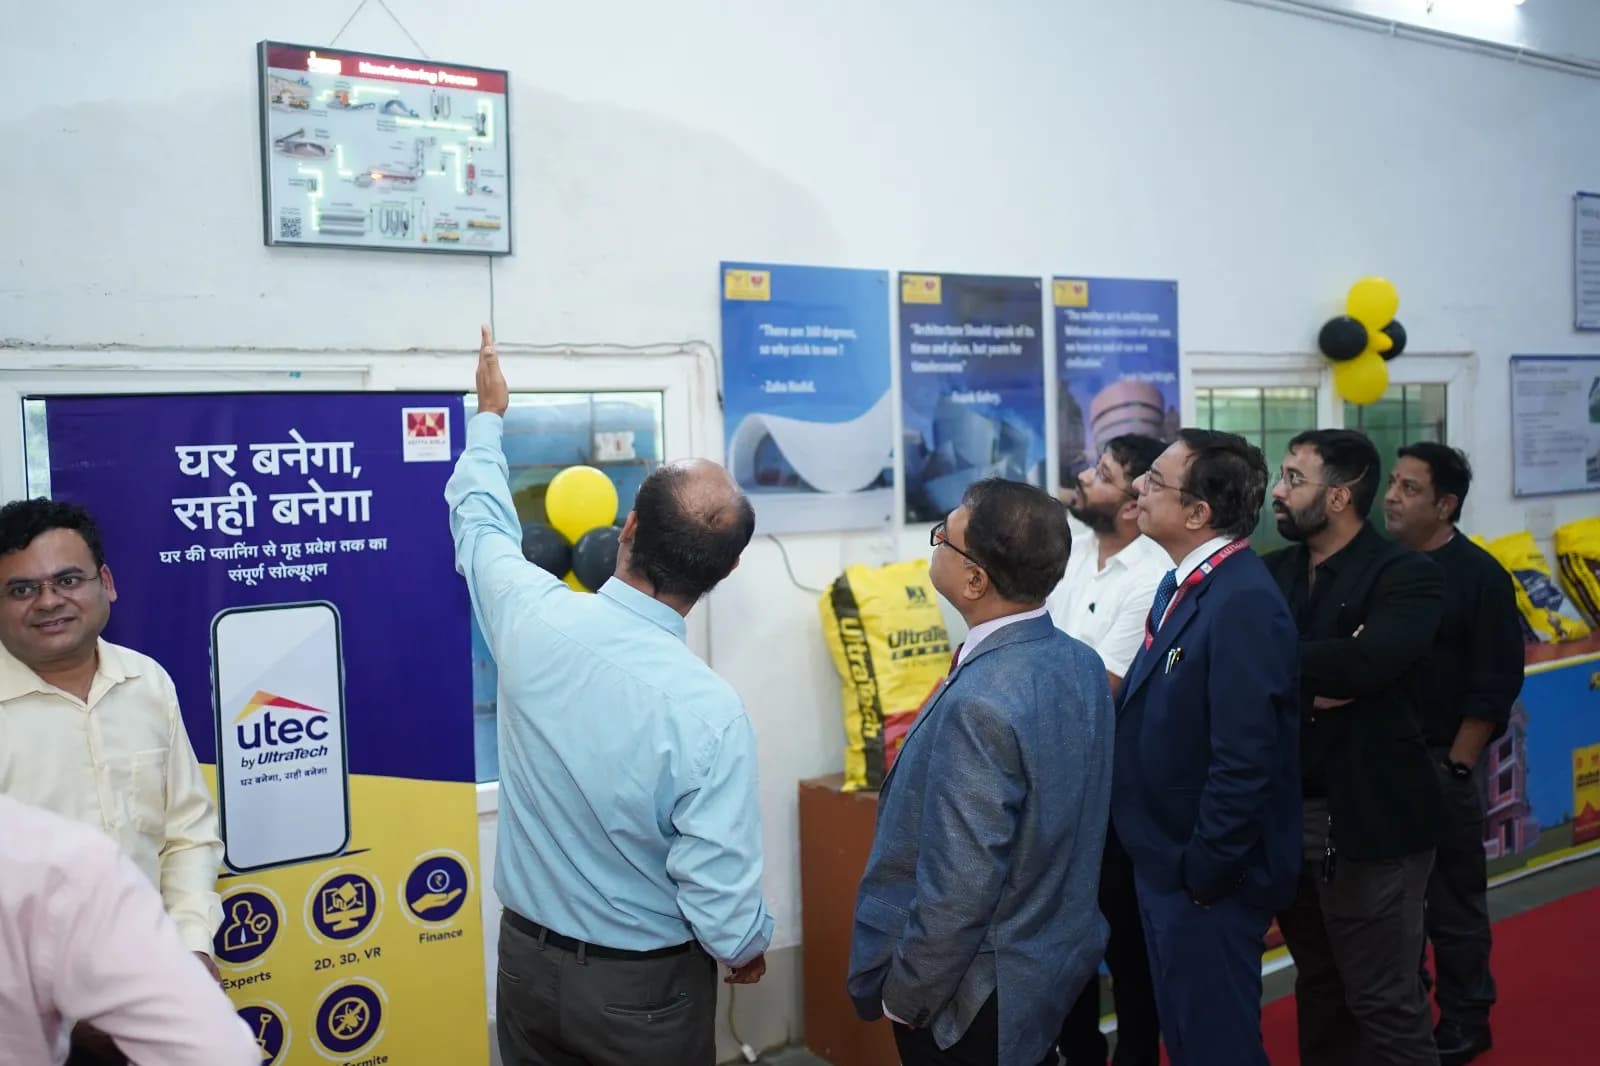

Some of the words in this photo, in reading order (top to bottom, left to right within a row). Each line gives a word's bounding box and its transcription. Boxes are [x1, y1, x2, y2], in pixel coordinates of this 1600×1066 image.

[359, 61, 437, 83] Manufacturing
[438, 71, 478, 86] Process
[175, 444, 238, 478] घर
[250, 428, 361, 479] बनेगा,
[172, 482, 257, 535] सही
[269, 478, 373, 525] बनेगा
[160, 550, 181, 563] घर
[185, 545, 206, 562] की
[210, 542, 258, 560] प्लानिंग
[262, 540, 276, 557] से
[281, 543, 301, 560] गृह
[305, 537, 336, 555] प्रवेश
[340, 539, 364, 552] तक
[368, 537, 388, 550] का
[228, 563, 264, 585] संपूर्ण
[269, 561, 328, 582] सोल्यूशन
[237, 712, 329, 749] utec
[241, 756, 255, 770] by
[257, 745, 328, 765] UltraTech
[419, 928, 463, 943] Finance
[314, 959, 335, 971] 2D,
[340, 952, 360, 966] 3D,
[364, 947, 381, 959] VR
[223, 971, 272, 990] Experts
